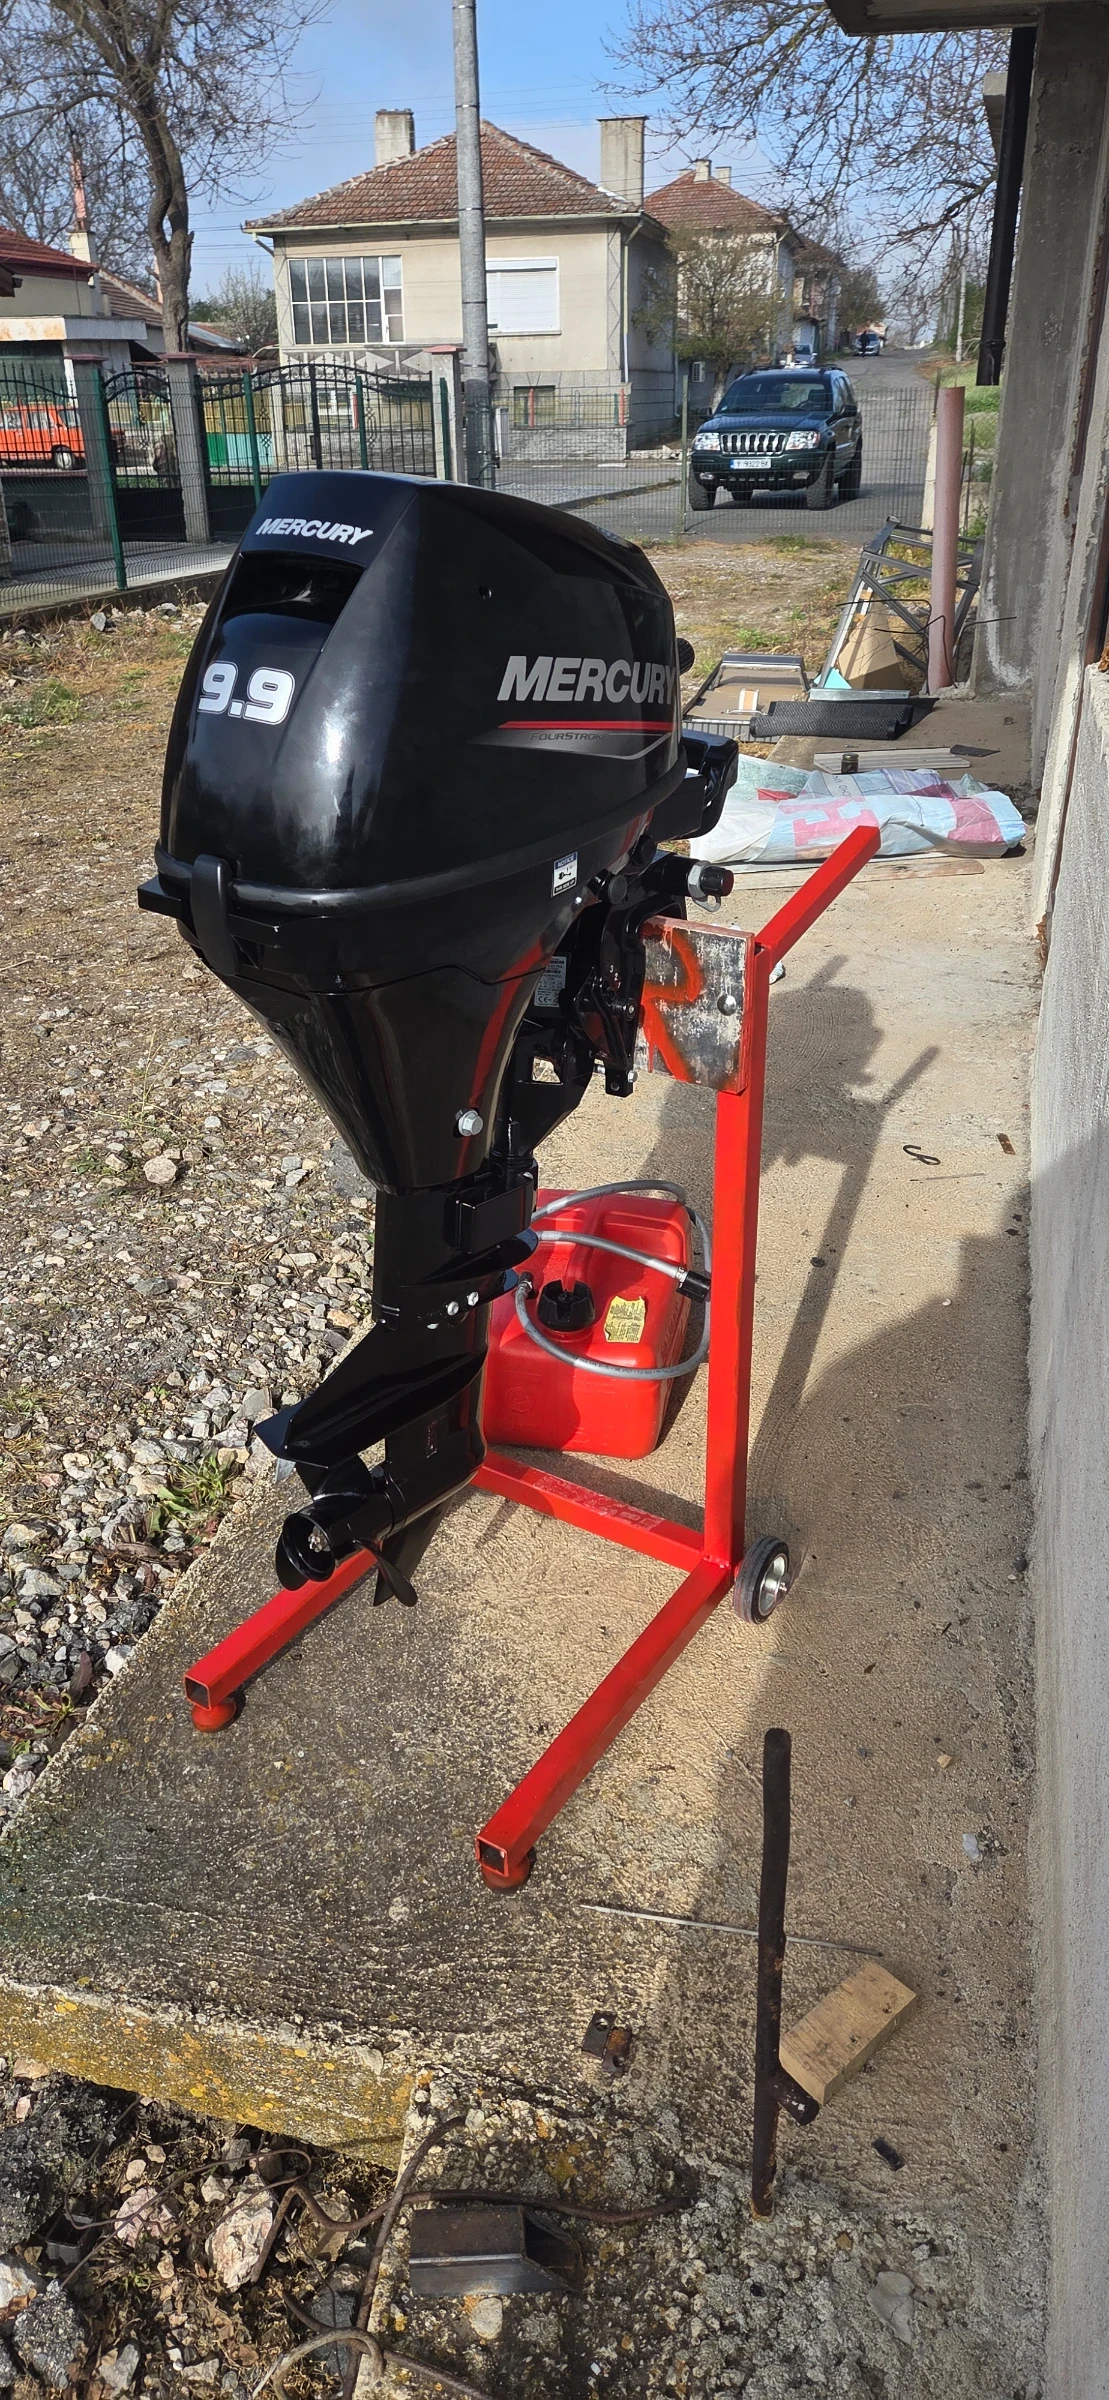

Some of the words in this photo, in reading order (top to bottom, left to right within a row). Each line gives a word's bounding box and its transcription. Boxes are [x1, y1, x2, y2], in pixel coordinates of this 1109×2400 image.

[255, 518, 374, 546] MERCURY
[197, 659, 295, 726] 9.9
[497, 655, 676, 705] MERCURY
